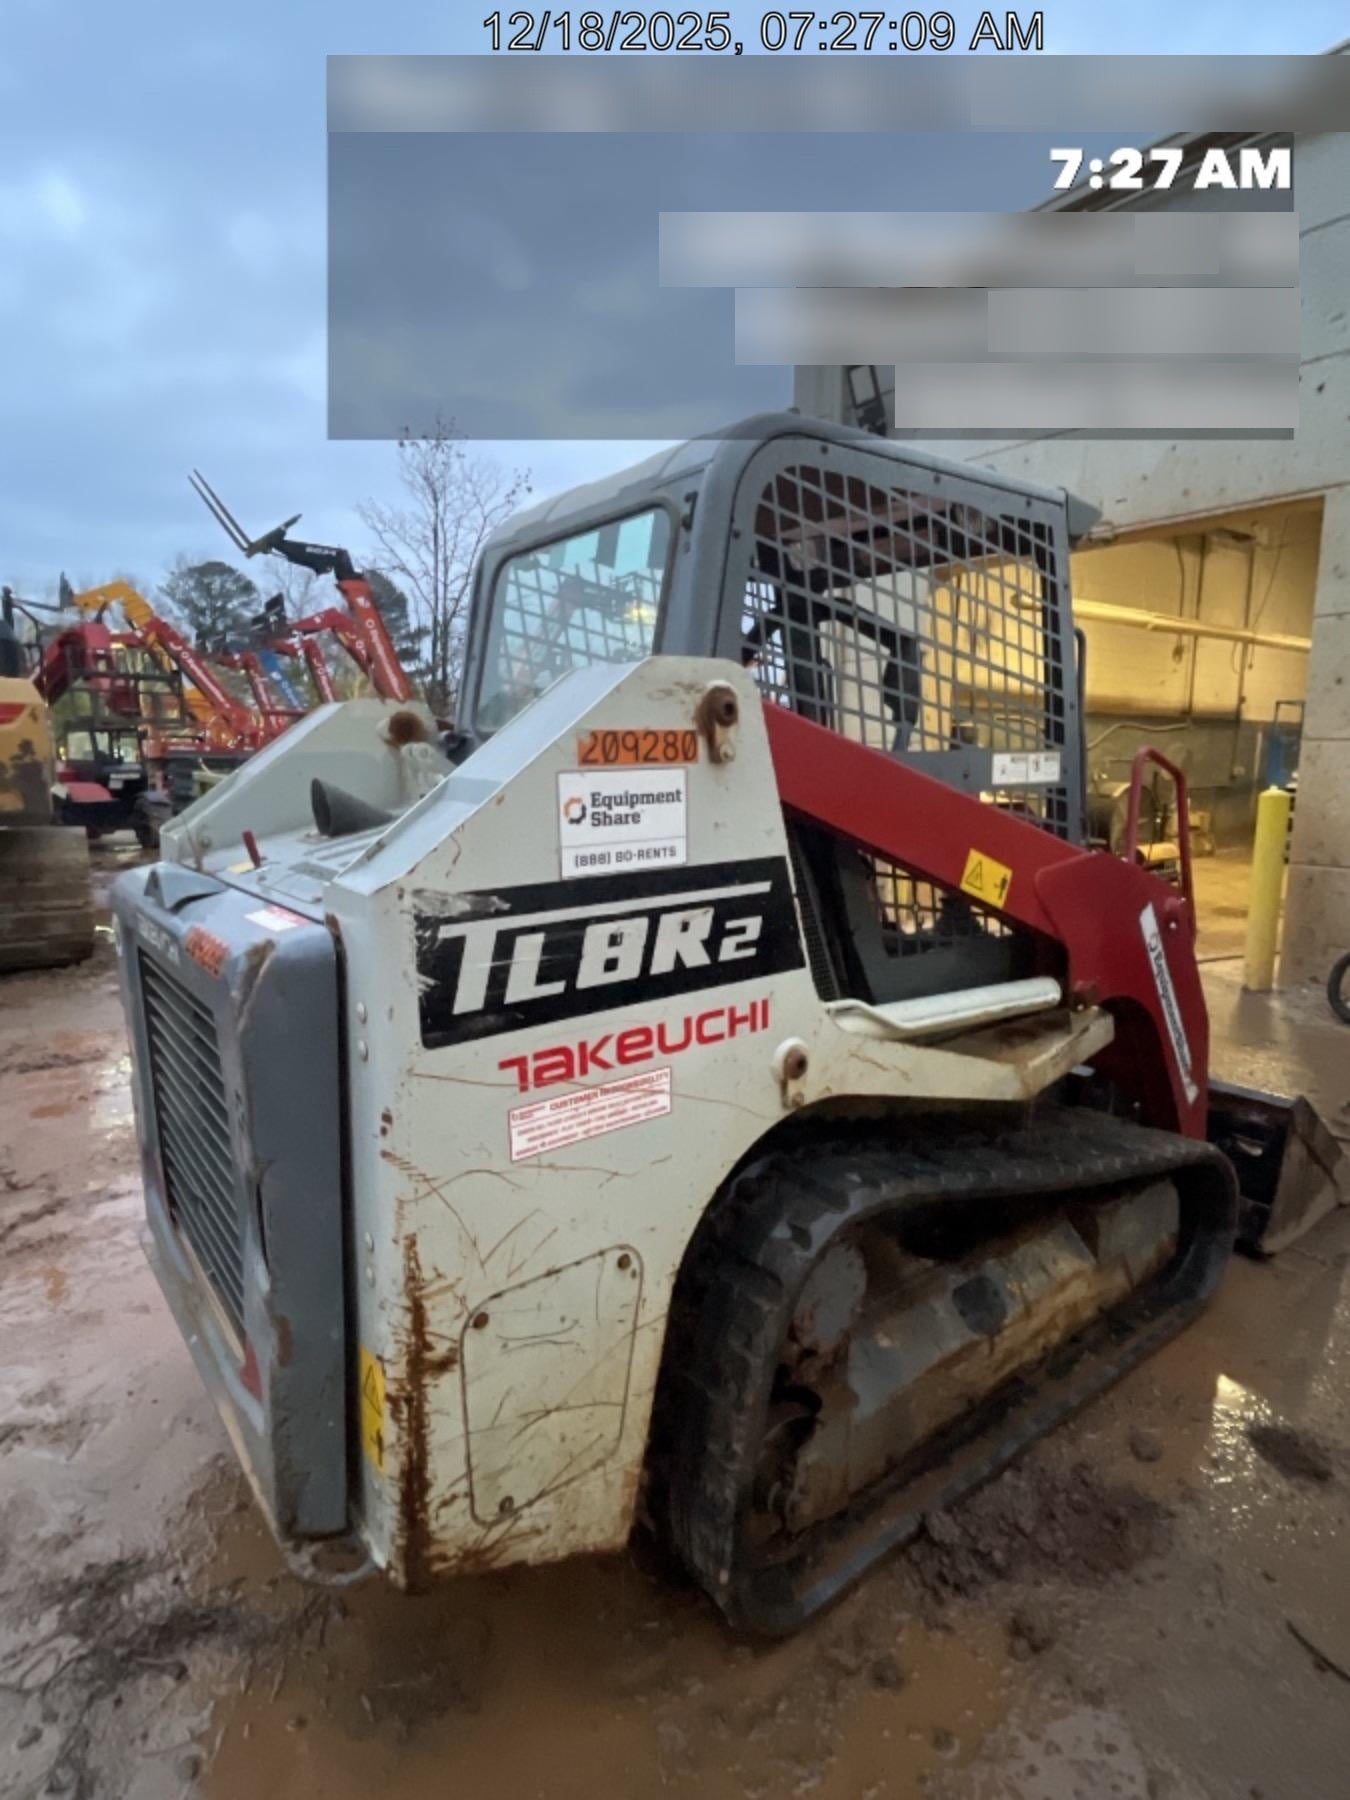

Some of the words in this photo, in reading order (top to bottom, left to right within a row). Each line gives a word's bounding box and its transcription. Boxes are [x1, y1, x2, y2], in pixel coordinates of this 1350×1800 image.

[580, 731, 697, 763] 209280
[590, 789, 682, 810] Equipment
[590, 811, 641, 827] Share
